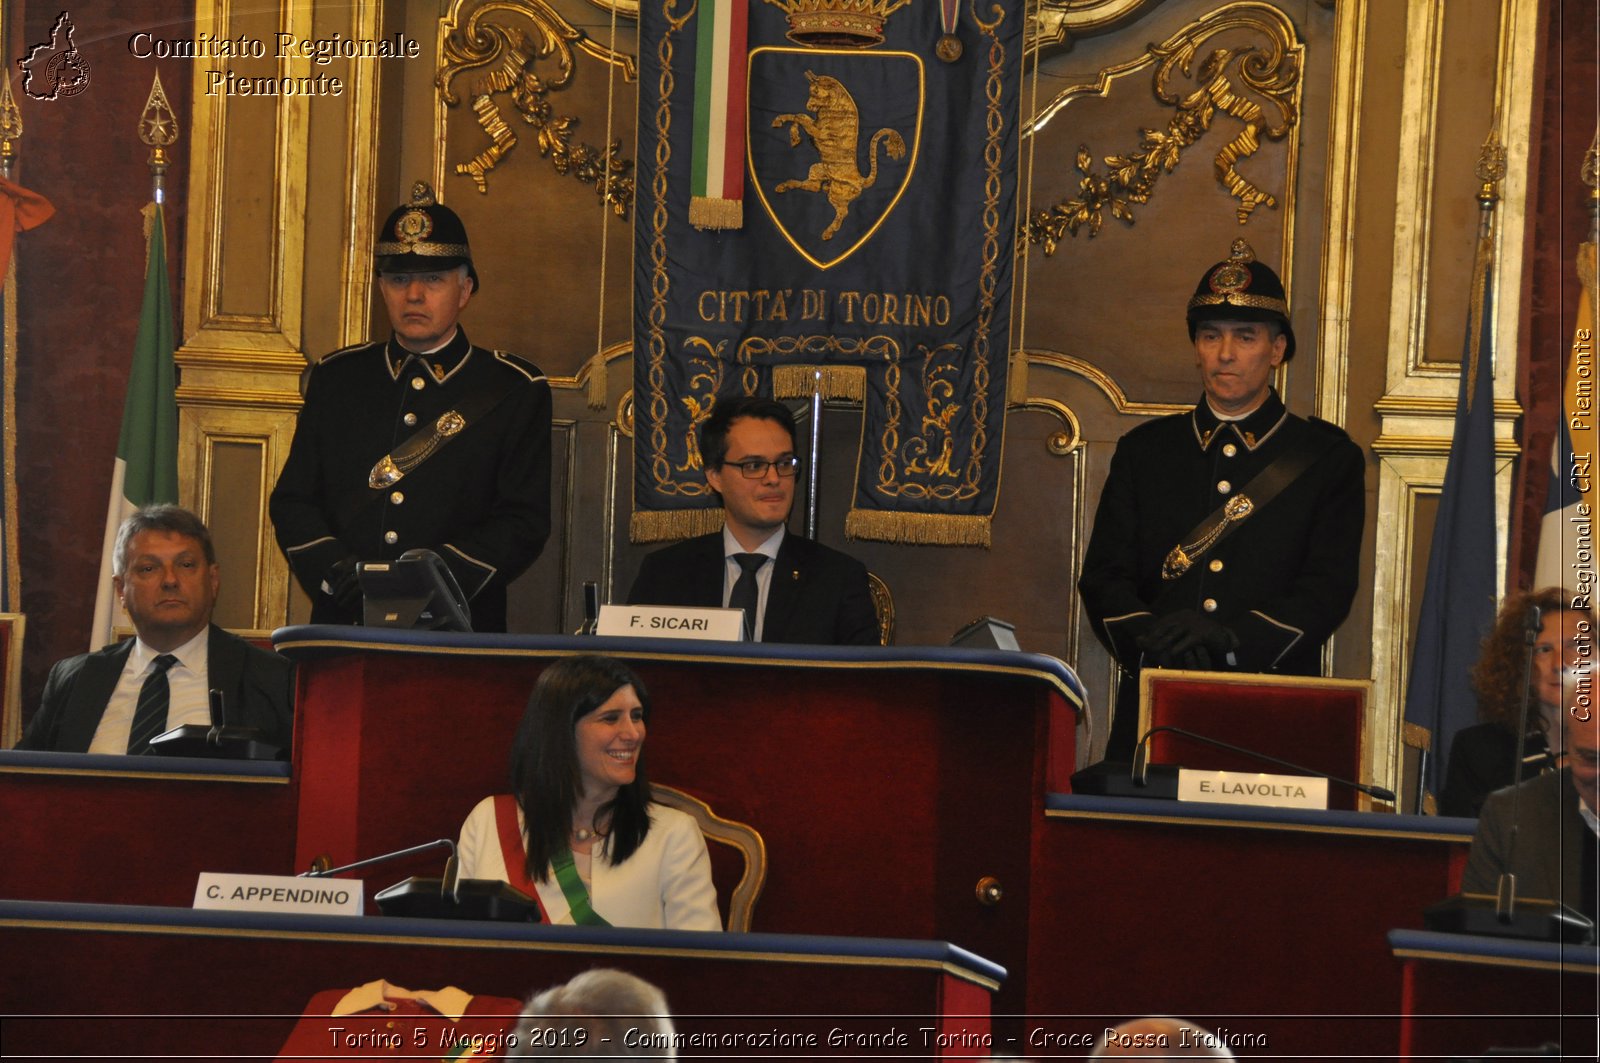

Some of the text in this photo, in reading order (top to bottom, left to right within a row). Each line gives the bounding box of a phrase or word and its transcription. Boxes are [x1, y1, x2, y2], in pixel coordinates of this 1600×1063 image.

[801, 289, 826, 321] DI
[838, 291, 951, 327] TORINO
[630, 615, 709, 631] F. SICARI
[1200, 780, 1306, 798] E. LAVOLTA
[206, 885, 350, 905] C. APPENDINO
